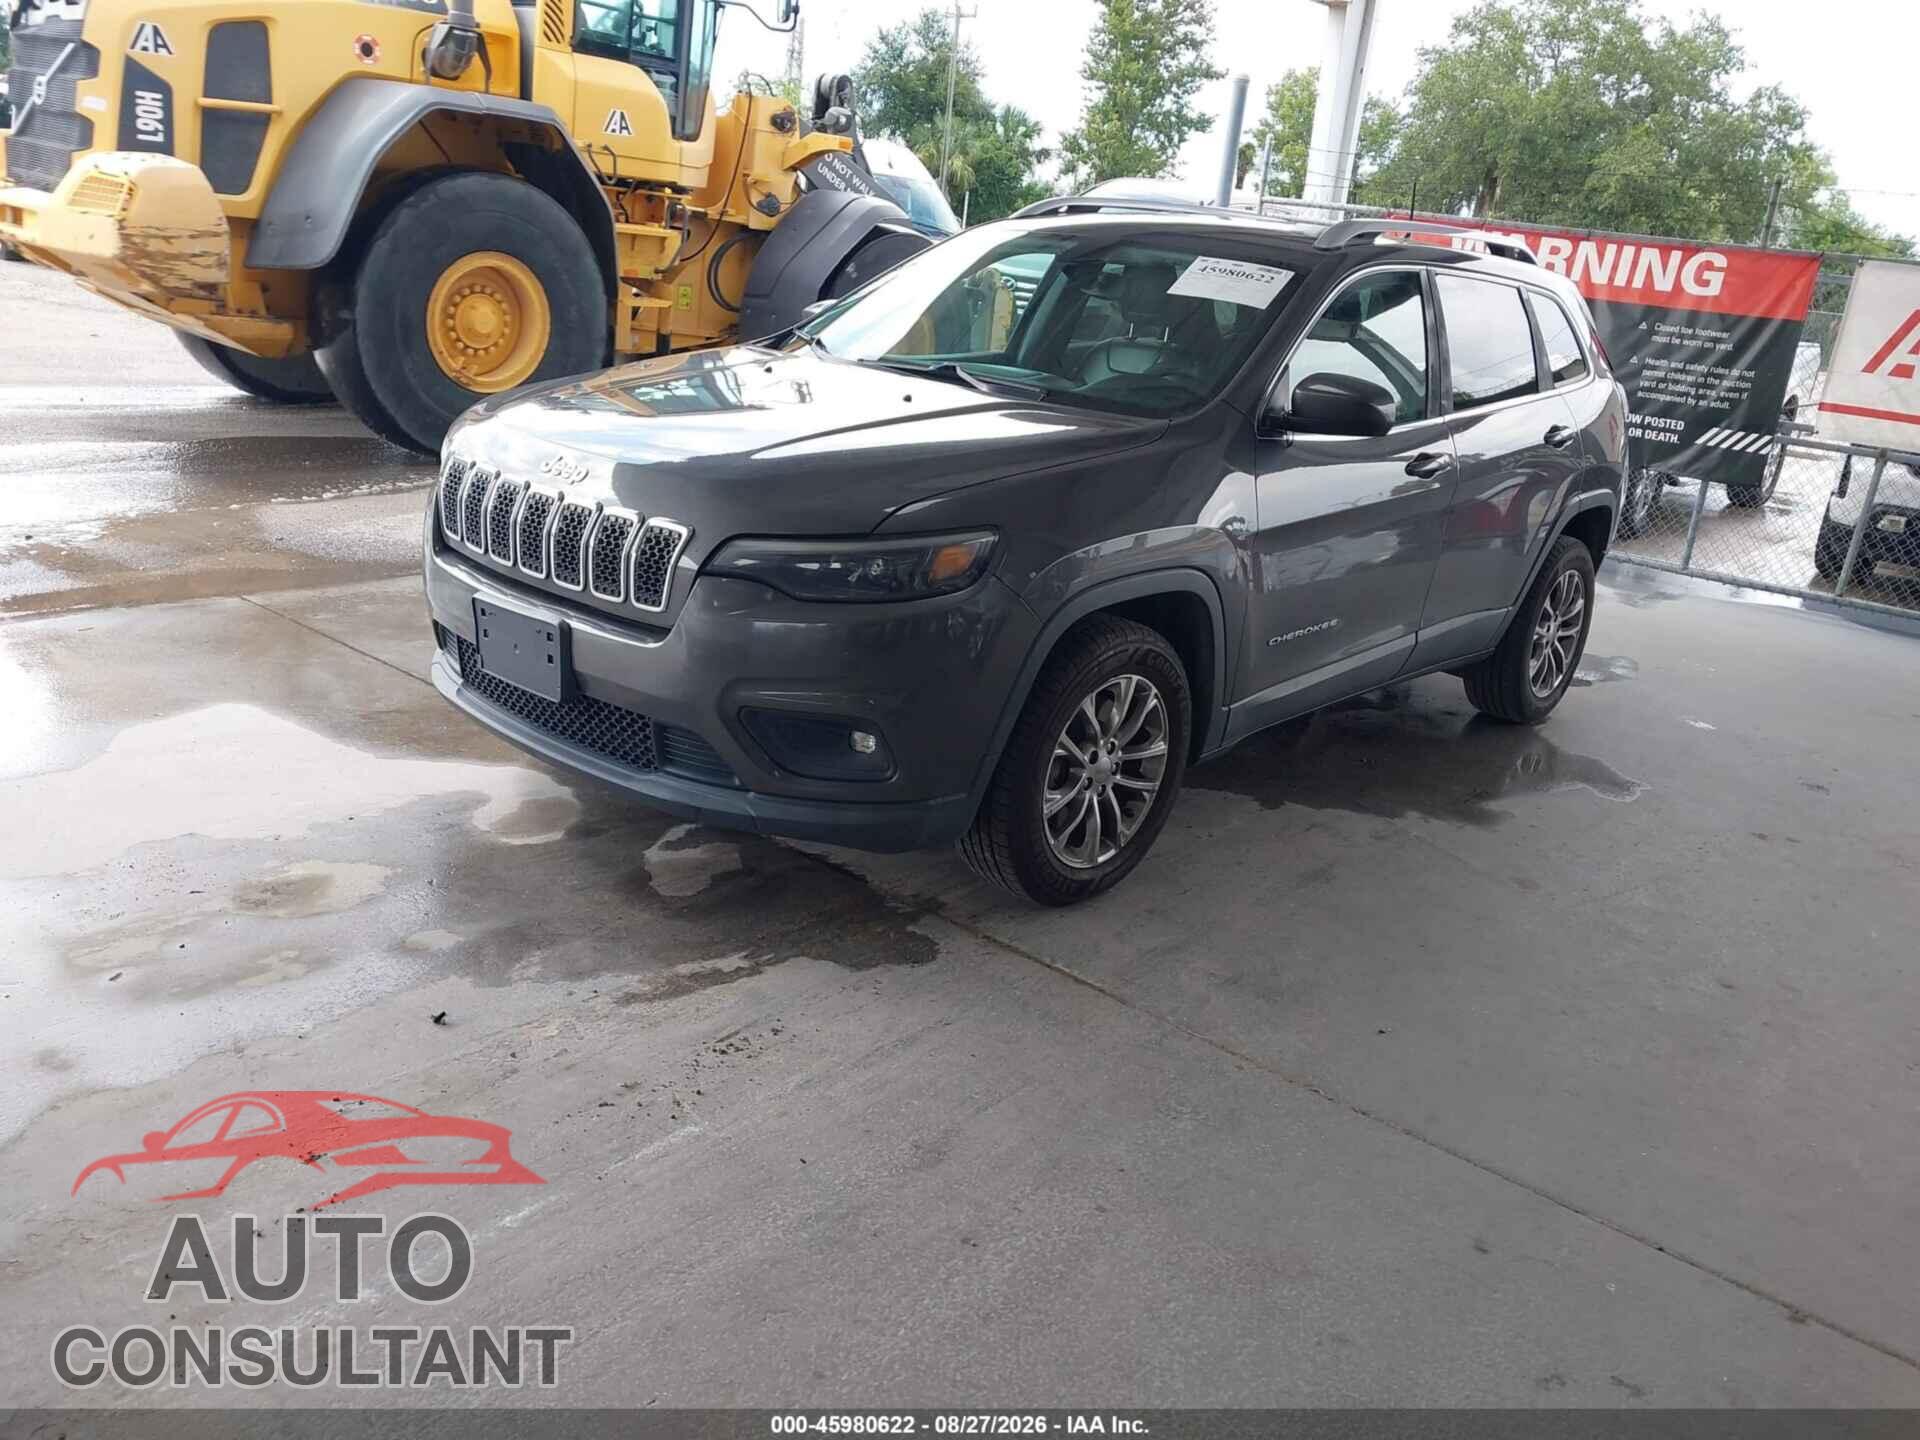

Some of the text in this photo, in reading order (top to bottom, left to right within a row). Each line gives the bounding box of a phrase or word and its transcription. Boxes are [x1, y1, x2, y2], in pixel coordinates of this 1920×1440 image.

[134, 89, 165, 143] L90H
[817, 161, 846, 193] UNDER
[832, 158, 853, 179] NOT
[1199, 264, 1276, 284] 45980622
[1654, 322, 1731, 339] Closed toe footwear
[1651, 334, 1671, 344] must
[1671, 335, 1682, 345] be
[1682, 338, 1702, 348] worn
[1703, 341, 1714, 349] on
[1645, 356, 1755, 378] Health and safety rules do not
[1641, 369, 1752, 389] permit children in the auction
[1637, 390, 1731, 409] accompanied by an adult.
[1639, 380, 1656, 390] yard
[1668, 383, 1696, 395] bidding
[1719, 390, 1740, 399] even
[1740, 391, 1749, 401] if
[1644, 415, 1685, 431] POSTED
[1628, 427, 1681, 444] OR DEATH.
[541, 455, 590, 487] Jeep
[1268, 617, 1339, 646] CHEROKEE
